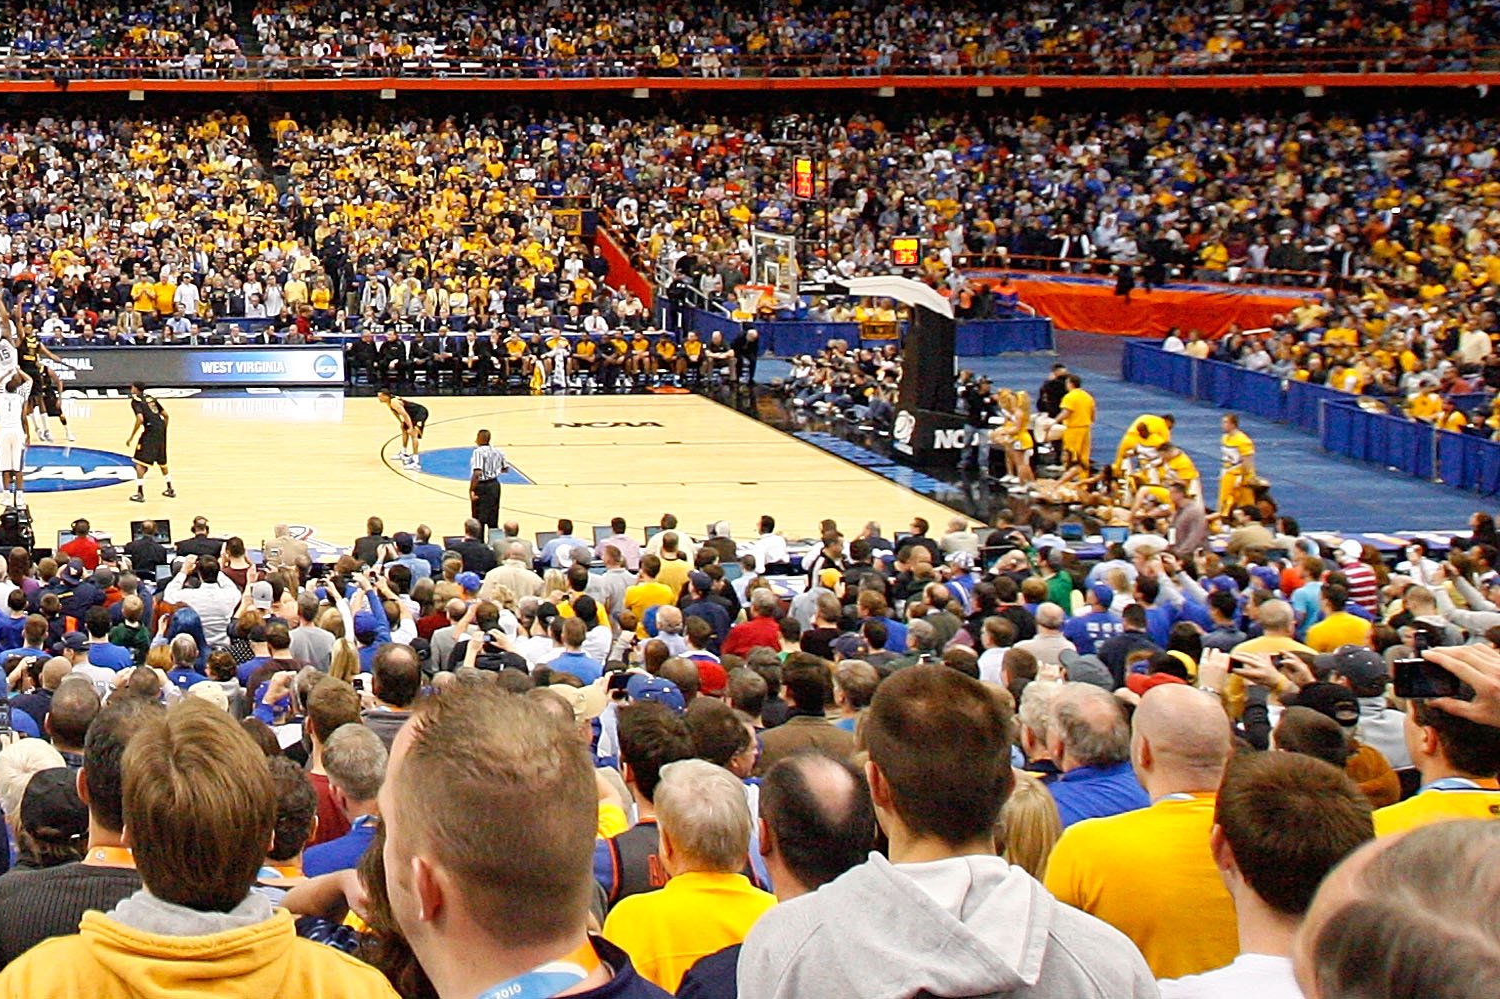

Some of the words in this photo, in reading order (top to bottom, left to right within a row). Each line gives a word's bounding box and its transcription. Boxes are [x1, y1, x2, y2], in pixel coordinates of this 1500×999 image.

[201, 361, 234, 374] WEST
[236, 361, 285, 374] VIRGINIA
[494, 983, 523, 999] 2010
